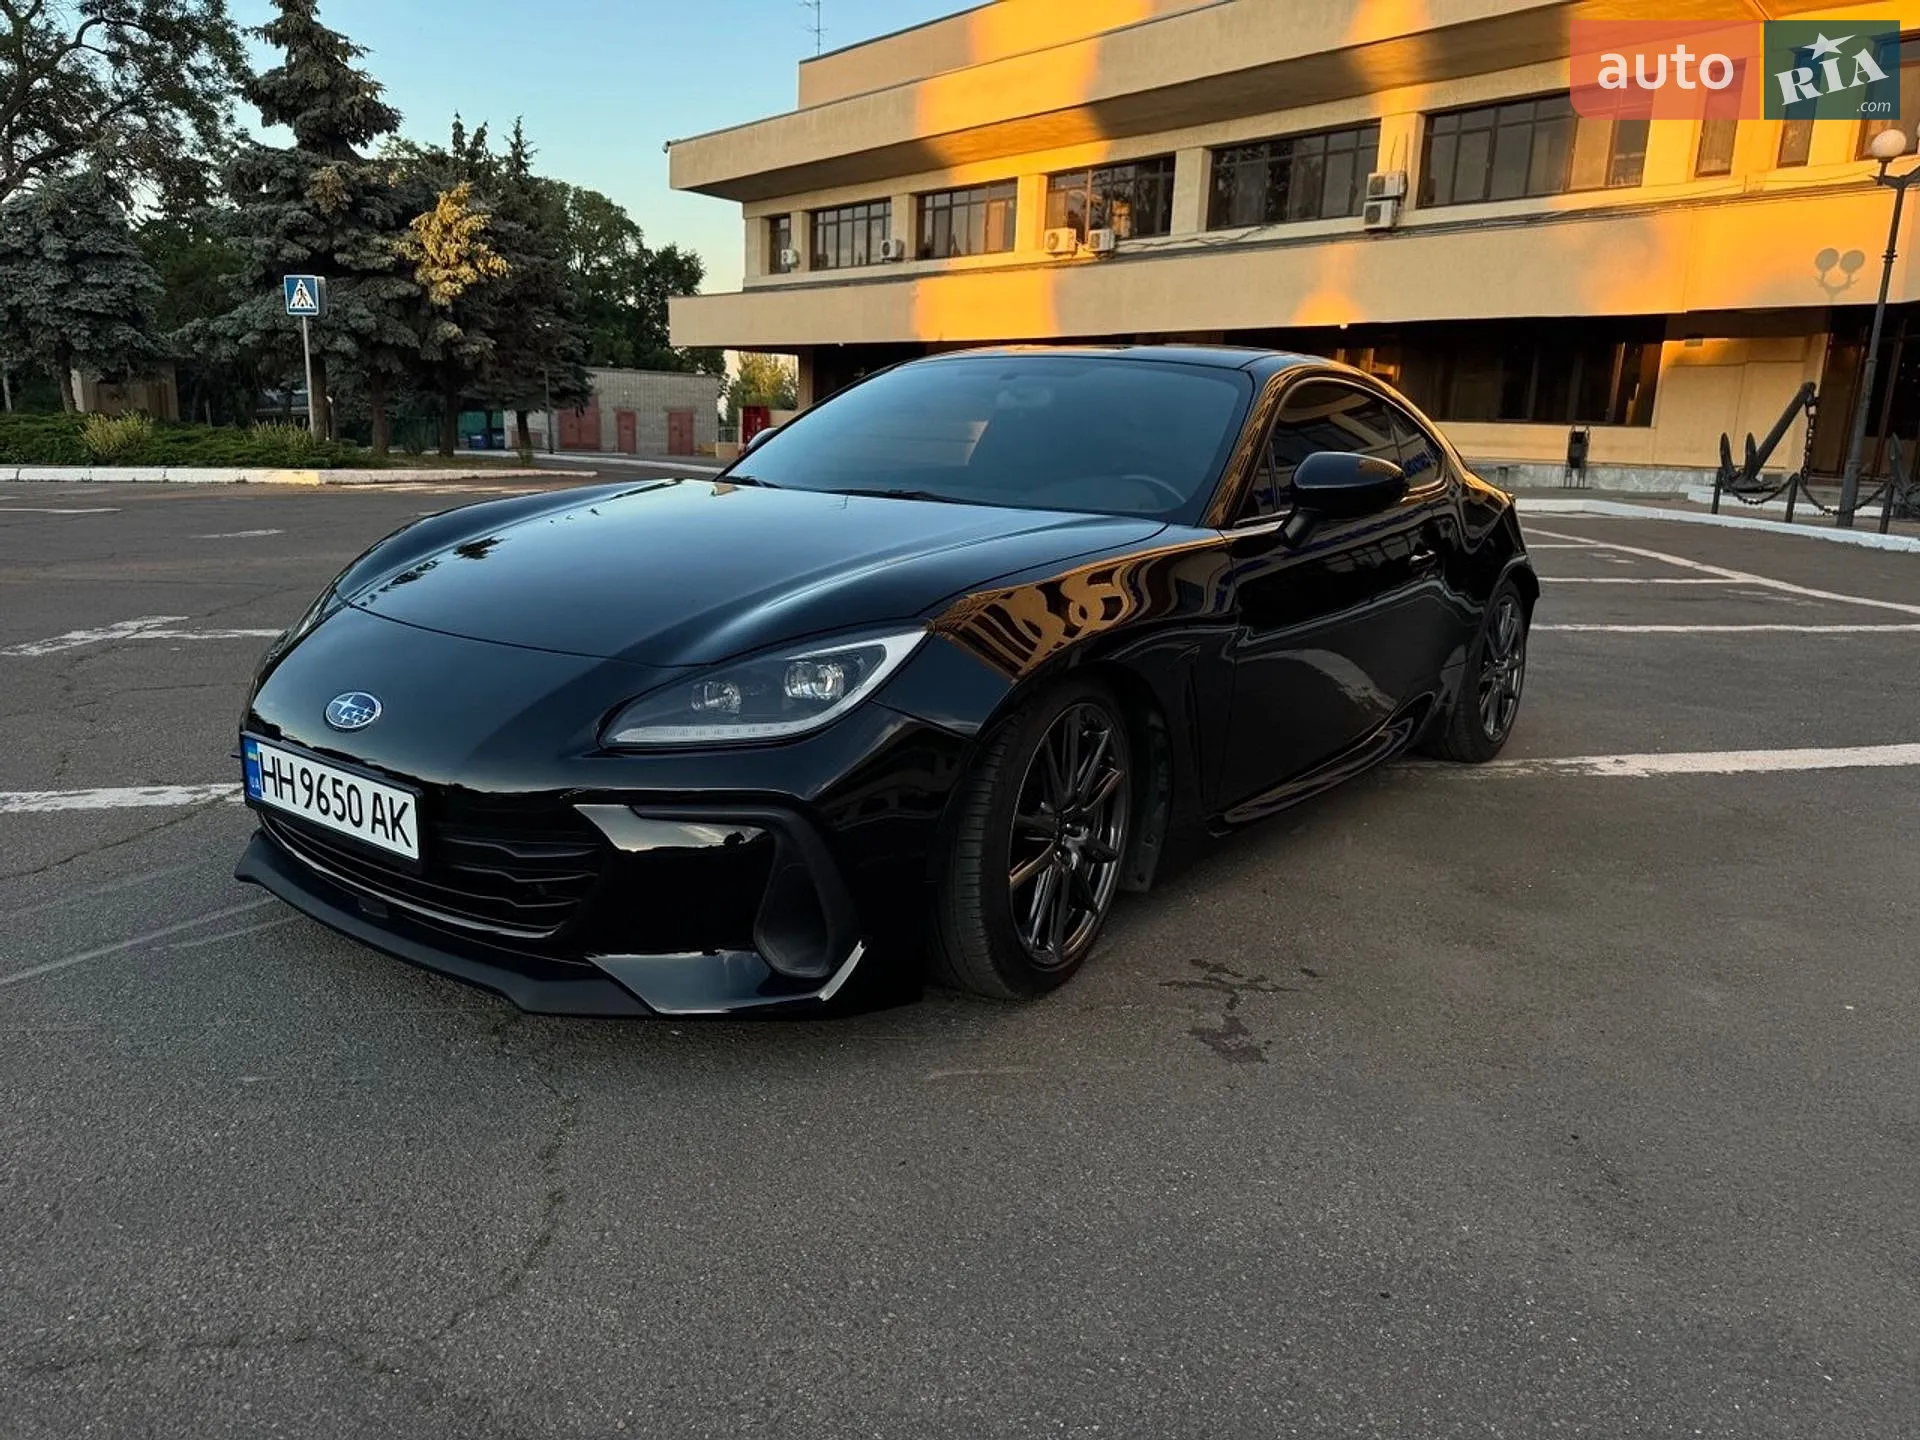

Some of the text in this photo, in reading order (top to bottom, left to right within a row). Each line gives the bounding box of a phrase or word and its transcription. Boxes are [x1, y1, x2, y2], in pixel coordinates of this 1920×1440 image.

[259, 751, 412, 848] HH 9650 AK
